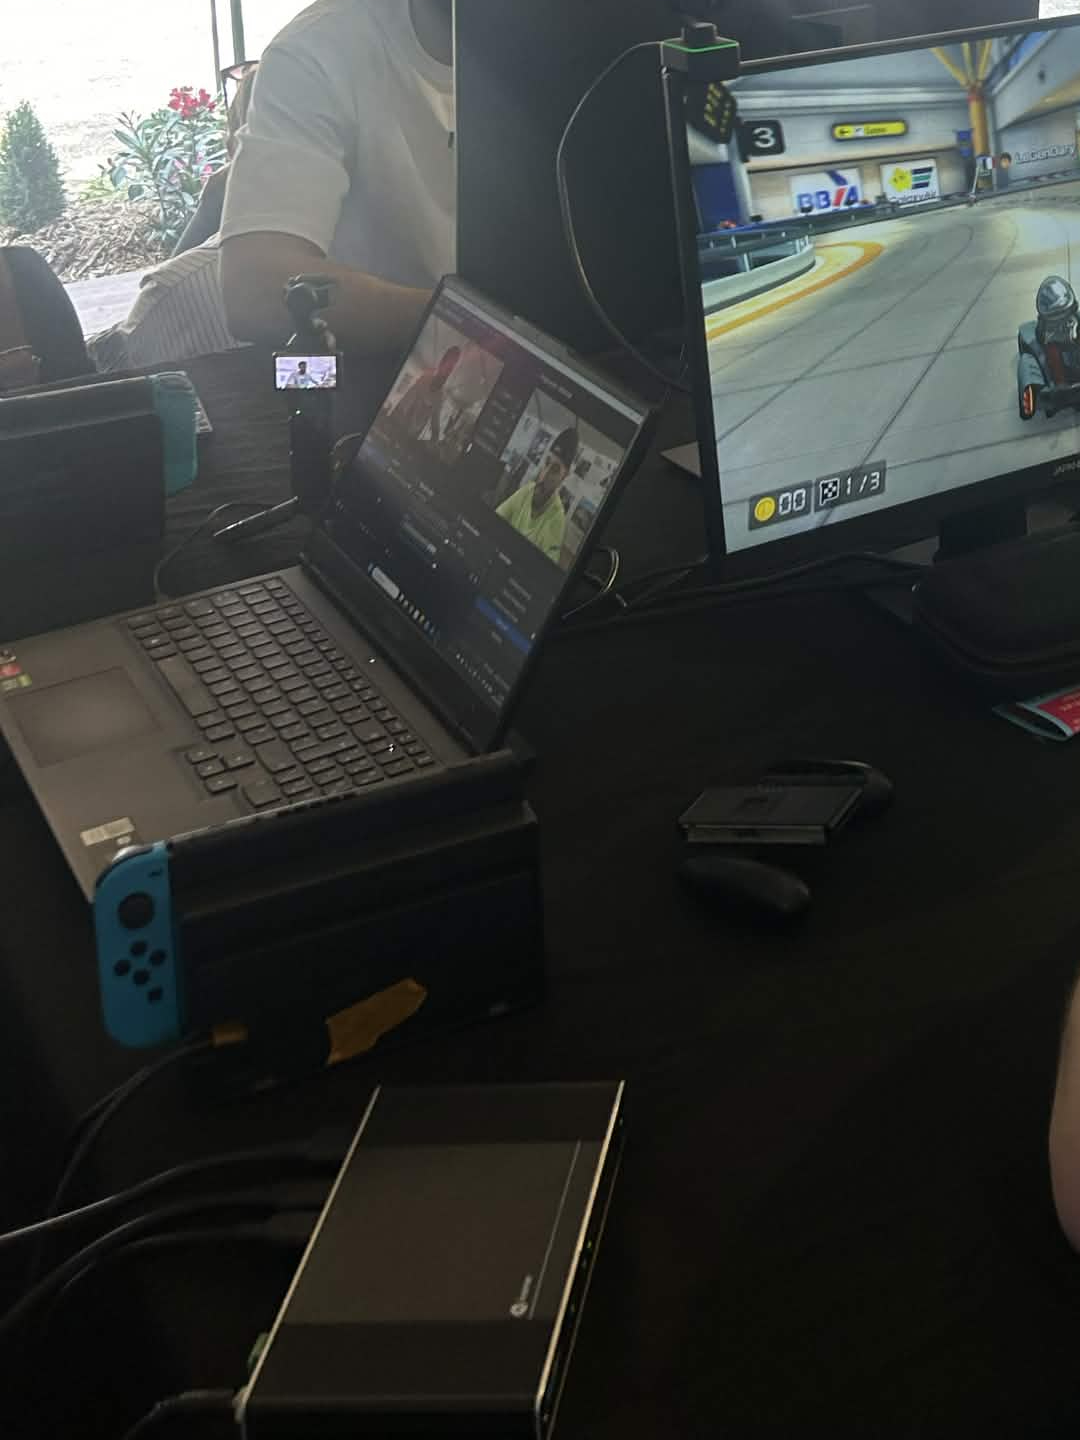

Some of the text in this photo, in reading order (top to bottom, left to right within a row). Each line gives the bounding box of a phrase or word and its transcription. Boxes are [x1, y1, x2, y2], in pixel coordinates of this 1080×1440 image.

[754, 126, 775, 149] 3
[846, 471, 880, 496] 1/3
[779, 488, 806, 516] 00
